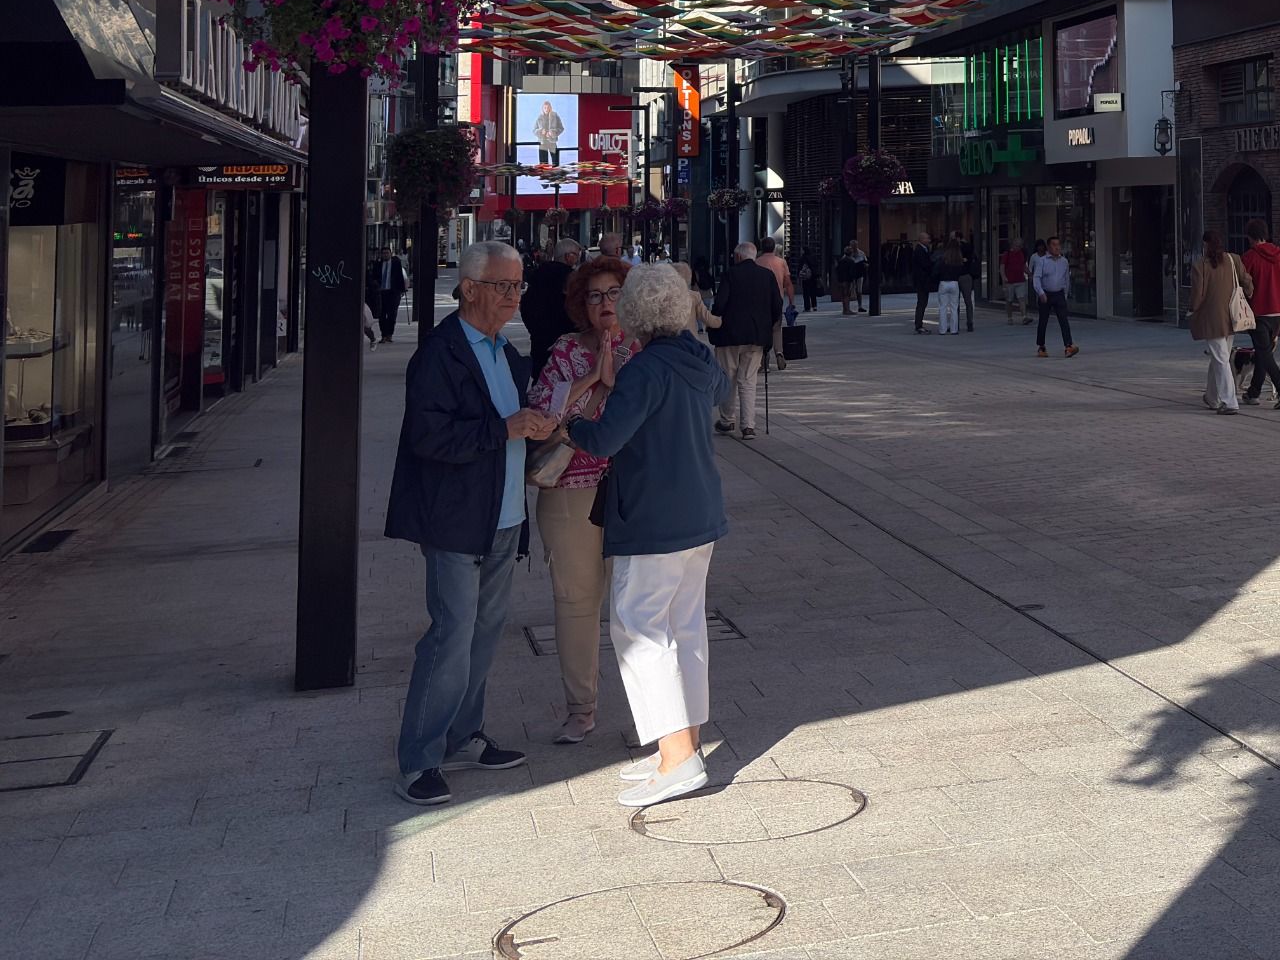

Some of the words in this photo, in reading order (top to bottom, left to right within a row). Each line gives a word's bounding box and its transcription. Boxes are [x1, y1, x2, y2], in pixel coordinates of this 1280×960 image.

[1233, 128, 1259, 152] THE
[890, 181, 915, 194] ARA
[188, 238, 200, 301] TABACS
